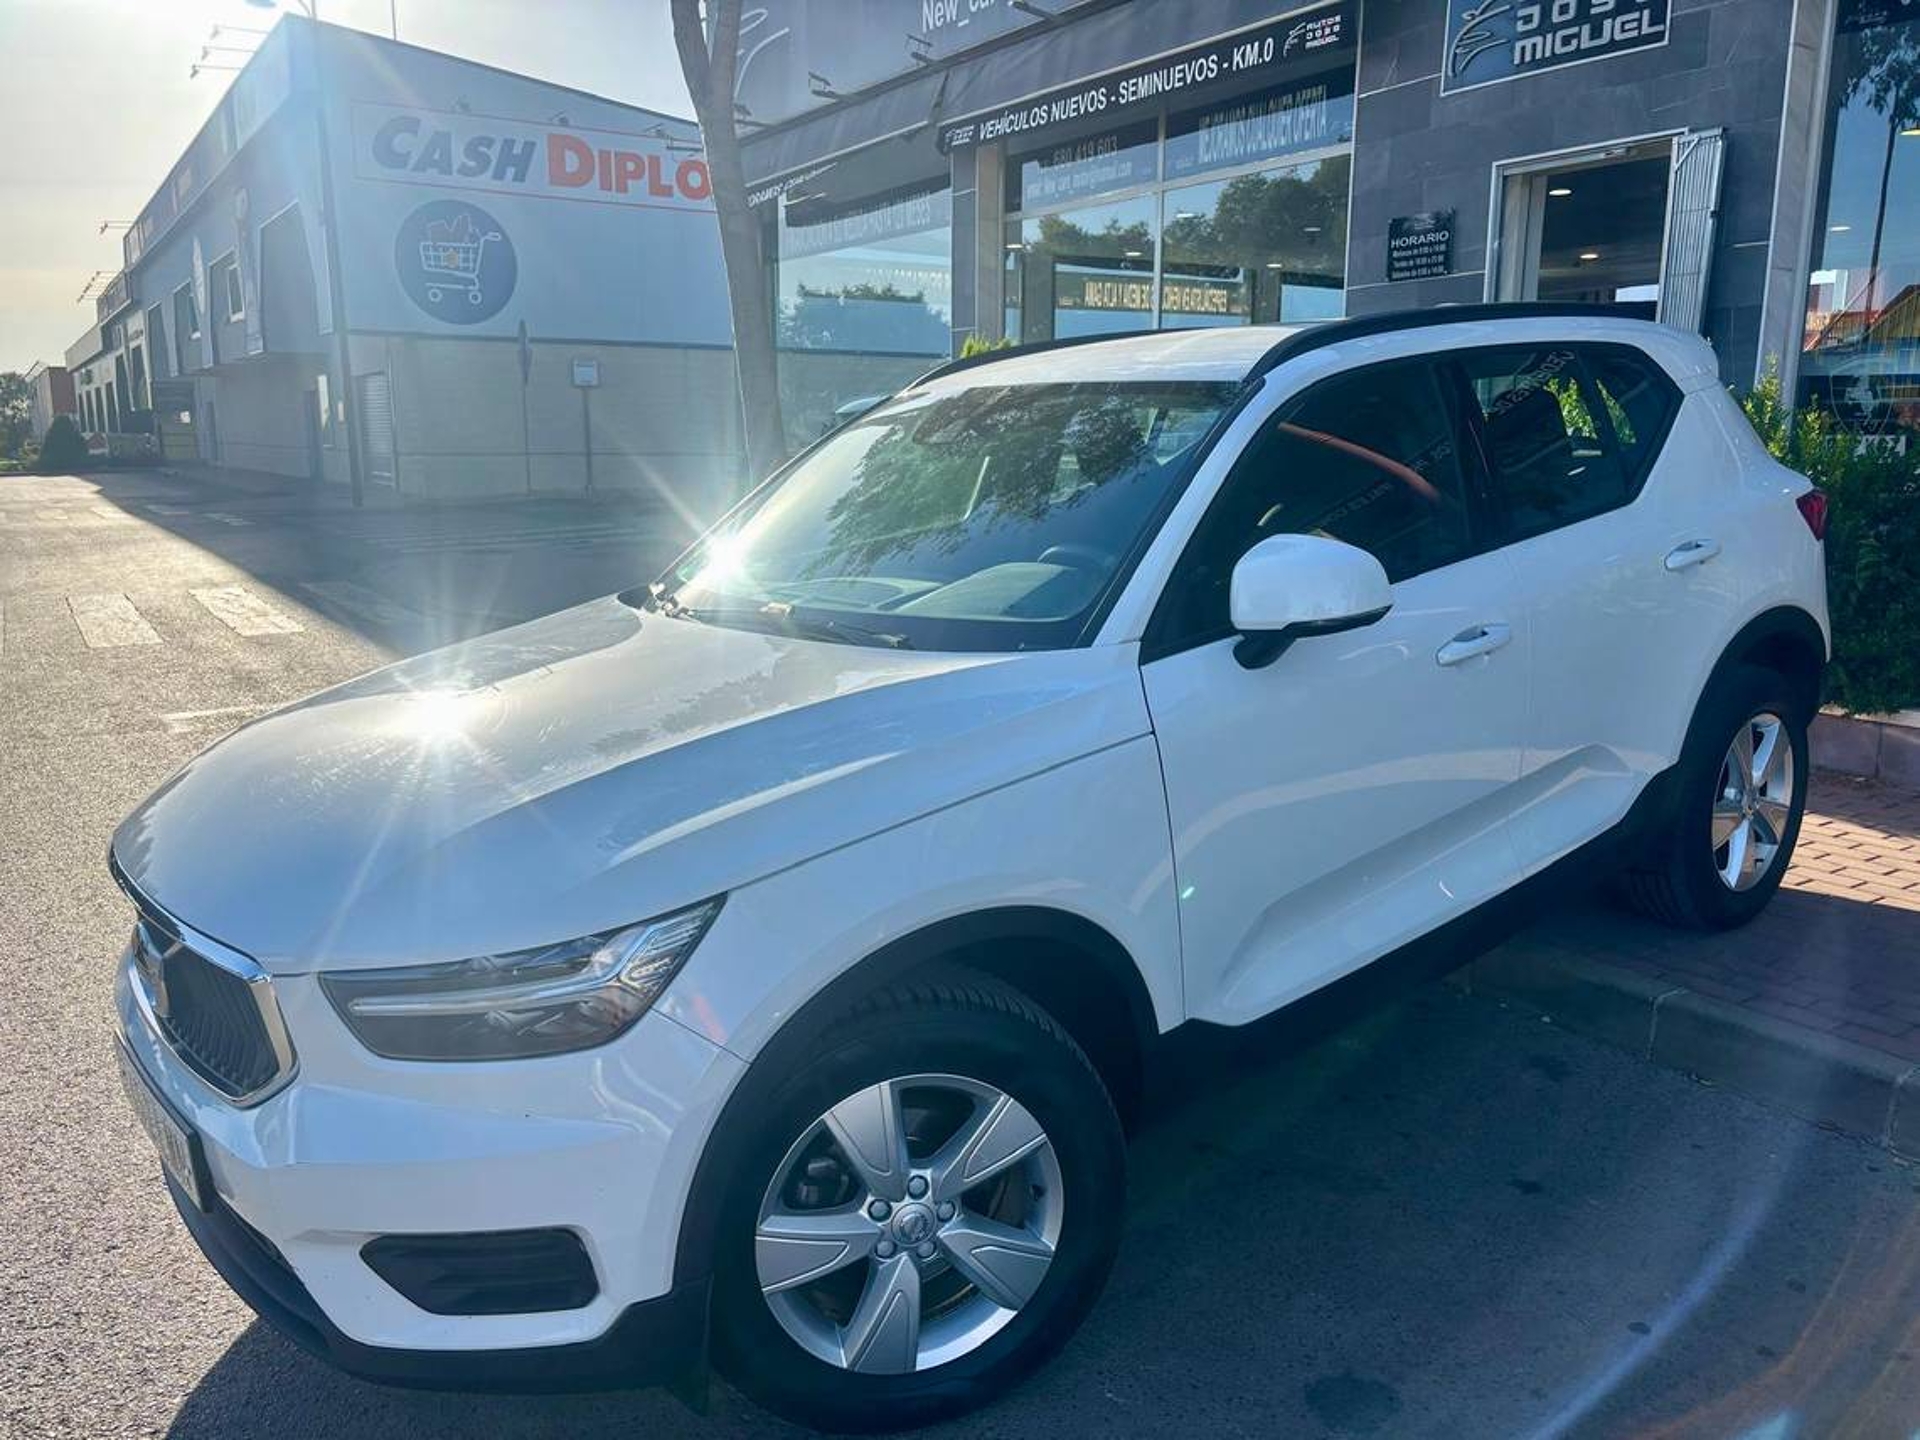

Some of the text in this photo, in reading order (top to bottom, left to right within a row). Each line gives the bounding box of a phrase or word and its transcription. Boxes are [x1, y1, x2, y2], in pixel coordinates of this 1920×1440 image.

[1513, 9, 1665, 65] MIGUEL
[1516, 0, 1651, 32] JOS
[979, 104, 1048, 140] VEHÍCULOS
[1051, 86, 1107, 121] NUEVOS
[1119, 55, 1218, 103] SEMINUEVOS
[1232, 38, 1274, 72] KM.0
[372, 116, 537, 183] CASH
[547, 134, 712, 200] DIPLO
[1390, 230, 1450, 249] HORARIO
